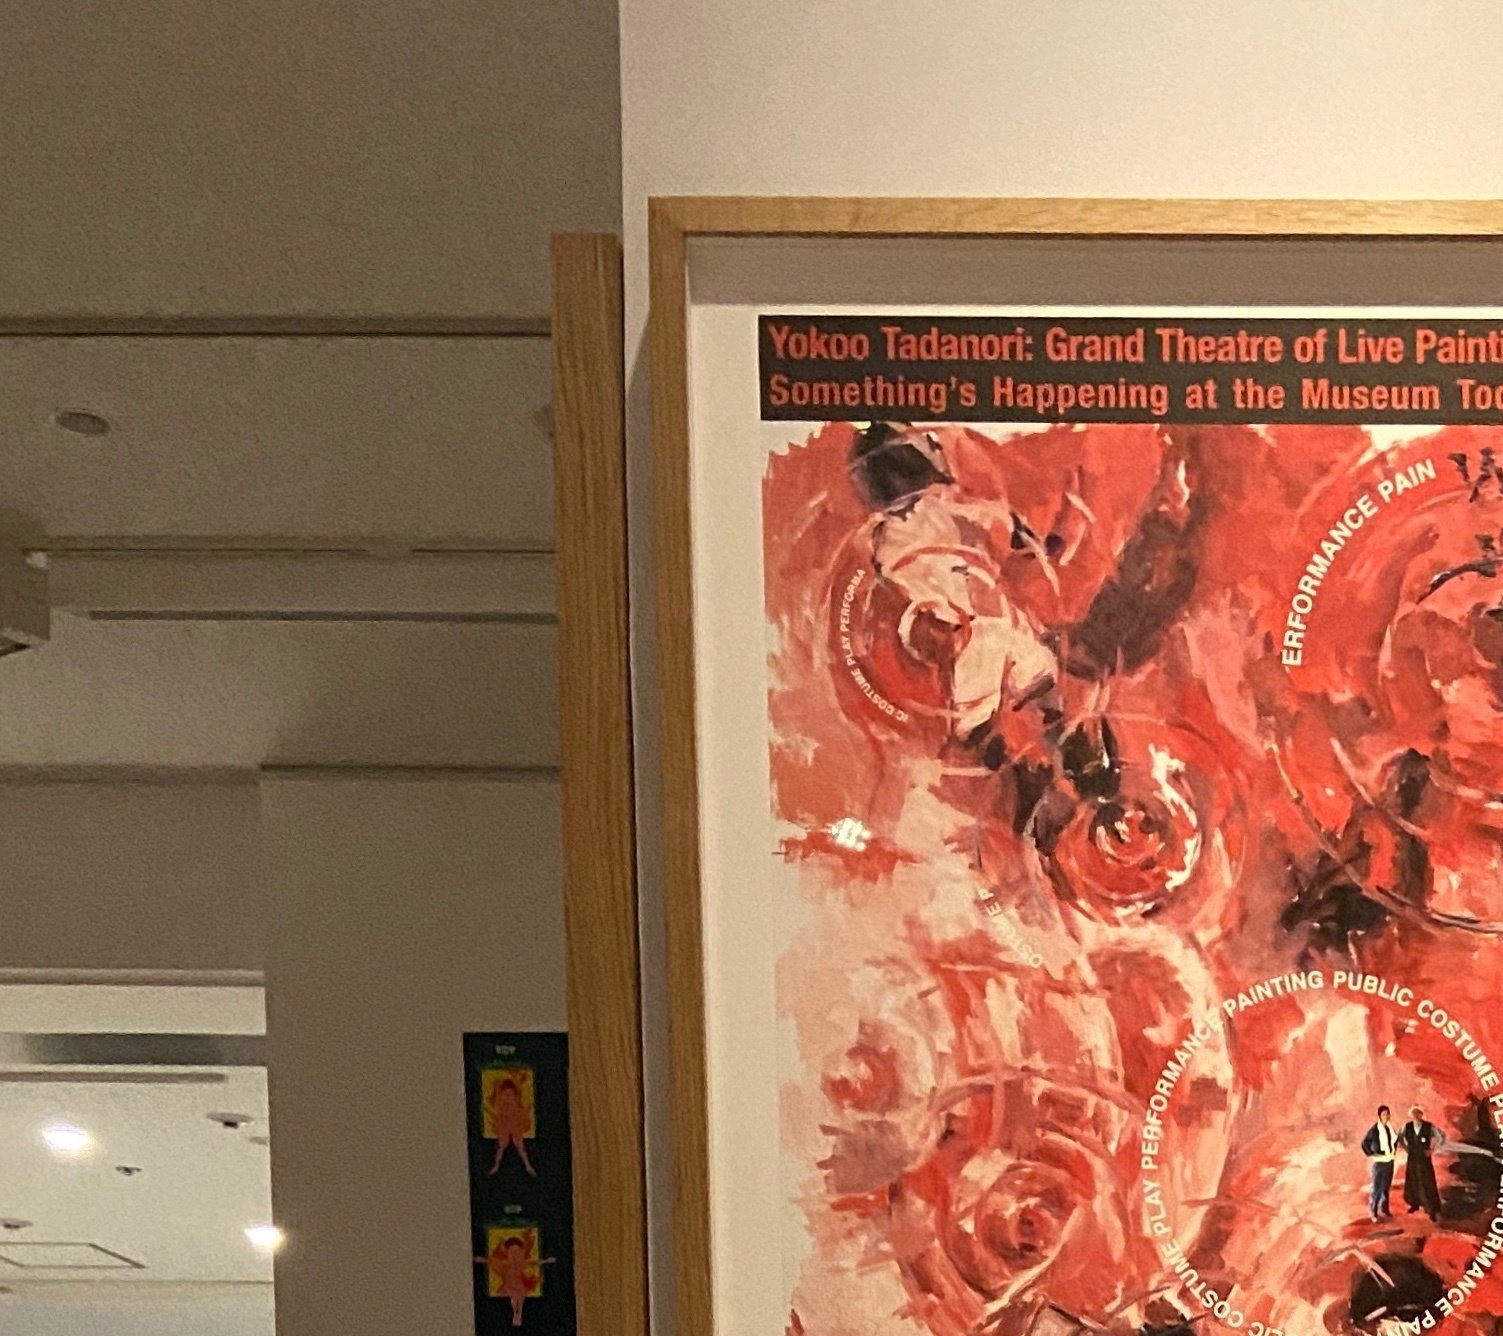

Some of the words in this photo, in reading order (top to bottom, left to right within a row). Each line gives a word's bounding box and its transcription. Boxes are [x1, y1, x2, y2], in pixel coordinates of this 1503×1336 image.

[770, 325, 869, 361] Yokoo
[881, 325, 1034, 362] Tadanori:
[1046, 327, 1144, 362] Grand
[1157, 327, 1283, 363] Theatre
[1294, 328, 1328, 363] of
[1338, 328, 1405, 363] Live
[770, 375, 977, 414] Something's
[993, 376, 1169, 416] Happening
[1185, 381, 1218, 410] at
[1232, 376, 1286, 411] the
[1302, 377, 1440, 412] Museum
[1282, 494, 1379, 667] ERFORMANCE
[1377, 458, 1437, 503] PAIN
[1222, 970, 1324, 1019] PAINTING
[1333, 970, 1414, 1008] PUBLIC
[1416, 999, 1501, 1092] COSTUME
[1140, 1010, 1224, 1172] PERFORMANCE
[1141, 1178, 1172, 1238] PLAY
[1160, 1239, 1245, 1328] COSTUME
